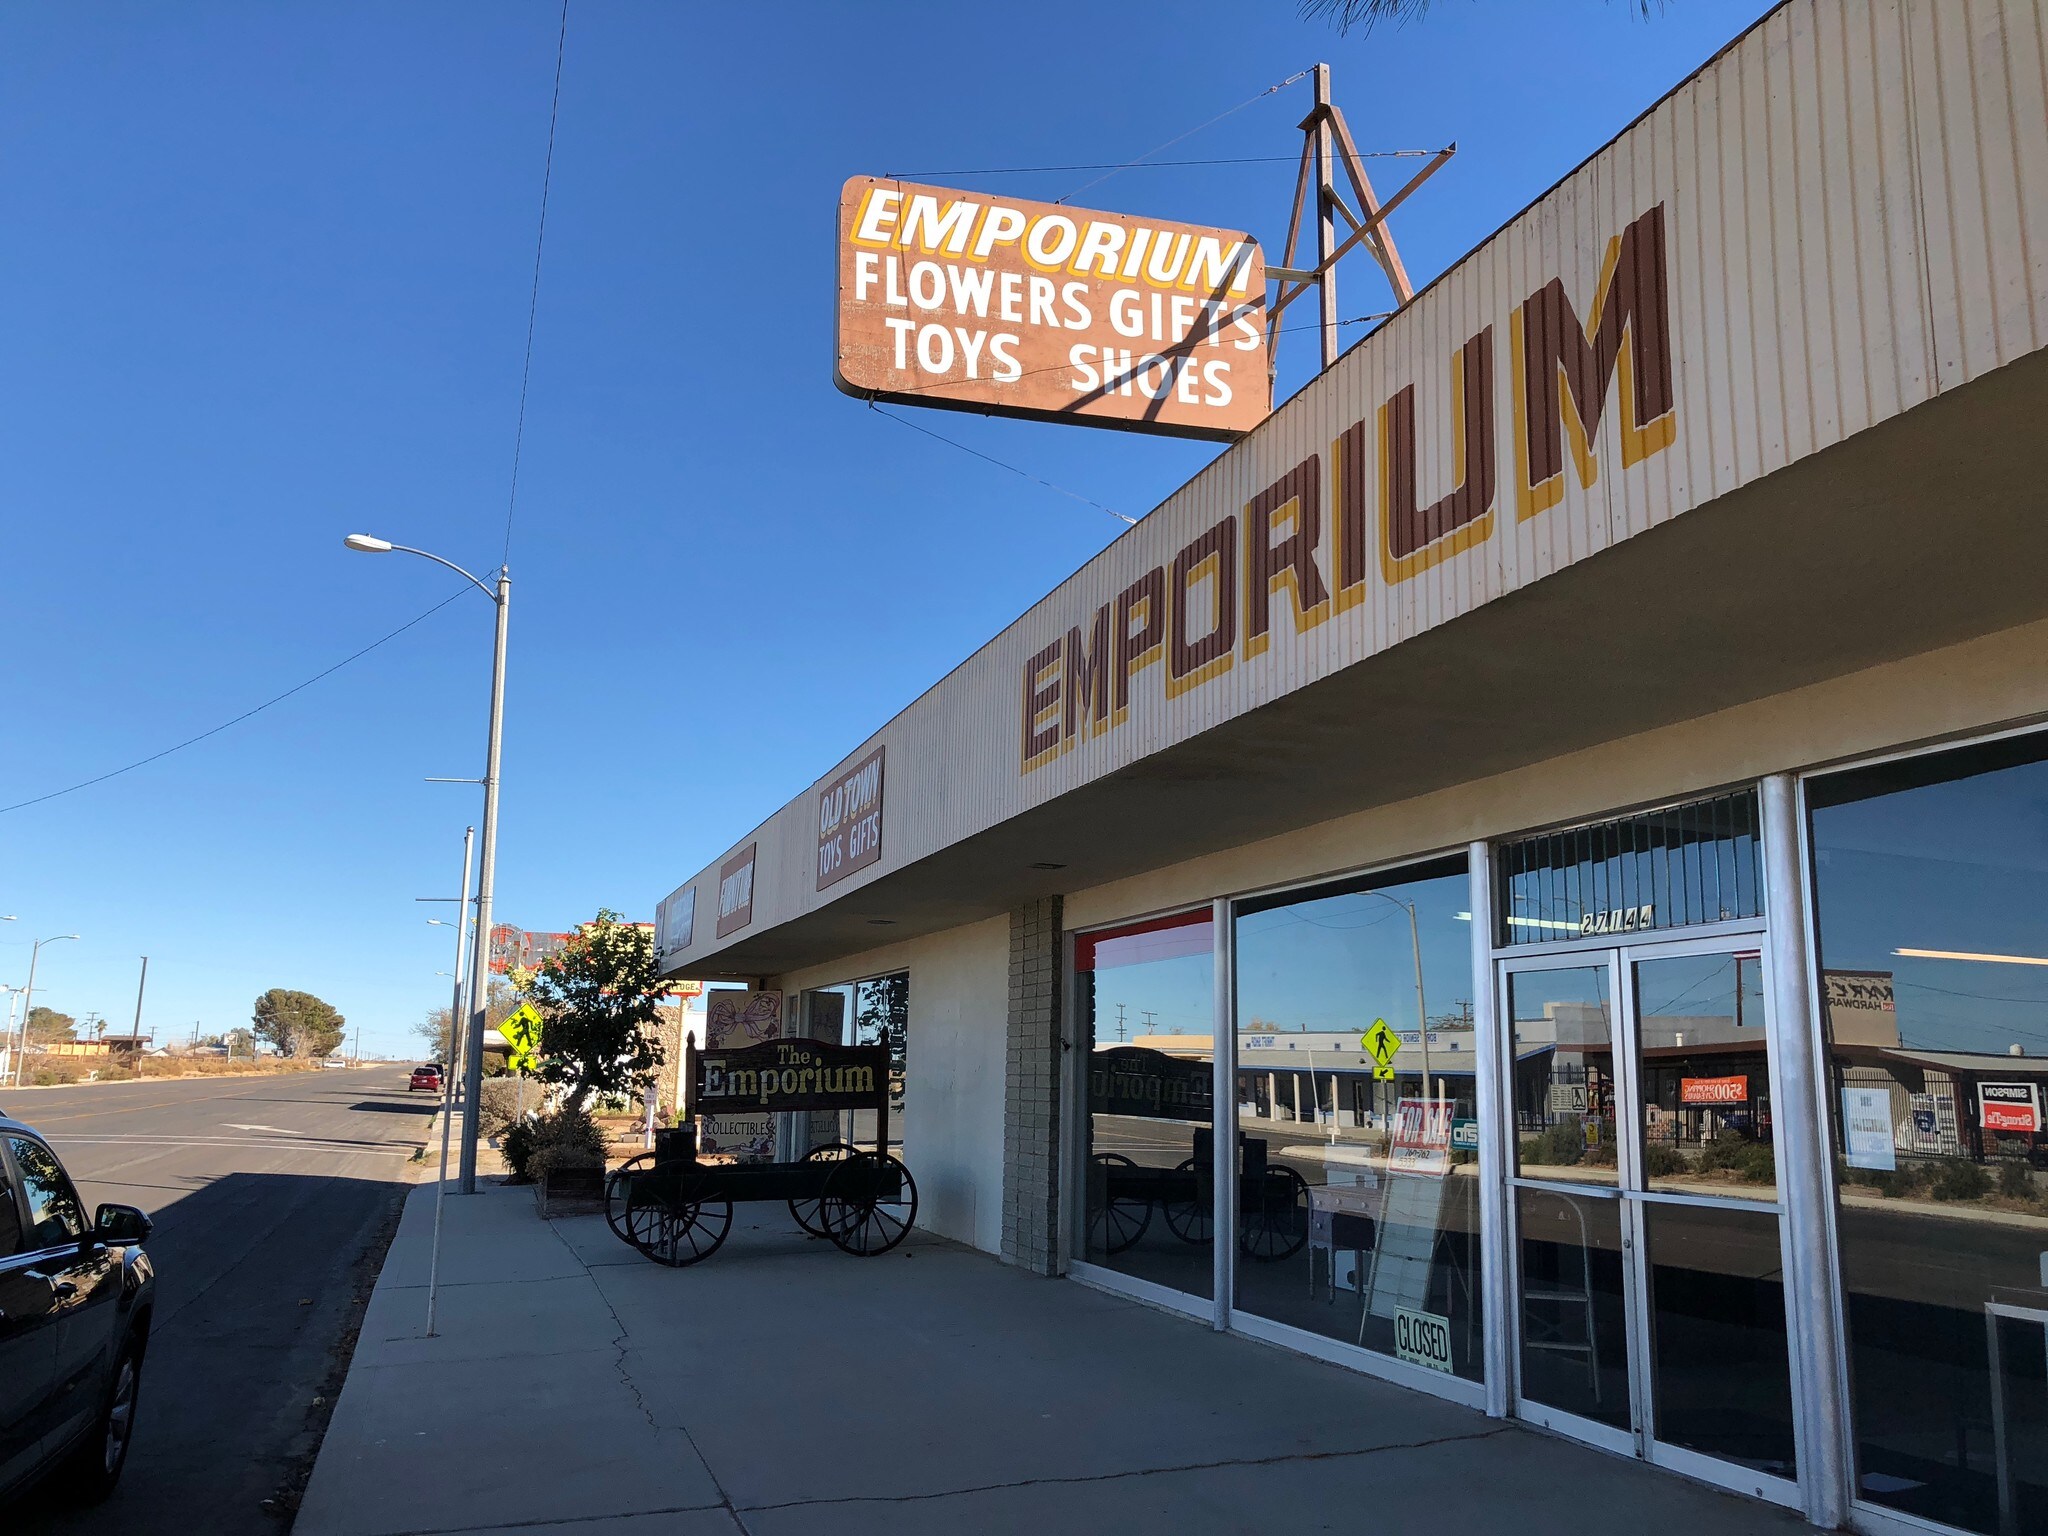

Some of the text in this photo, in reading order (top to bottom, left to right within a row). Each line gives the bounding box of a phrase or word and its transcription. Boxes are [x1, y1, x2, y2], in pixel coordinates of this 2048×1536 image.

[851, 188, 1257, 297] EMPORIUM
[855, 251, 1261, 352] FLOWERS GIFTS
[885, 318, 1233, 407] TOYS SHOES
[1021, 201, 1676, 775] EMPORIUM
[820, 756, 881, 838] OLD TOWN
[819, 810, 879, 877] TOYS GIFTS
[1583, 906, 1651, 934] 27144
[702, 1057, 875, 1104] Emporium
[777, 1045, 810, 1065] The
[706, 1121, 772, 1135] COLLECTIBLES
[1396, 1107, 1452, 1146] FOR SALE
[1398, 1314, 1448, 1362] CLOSED
